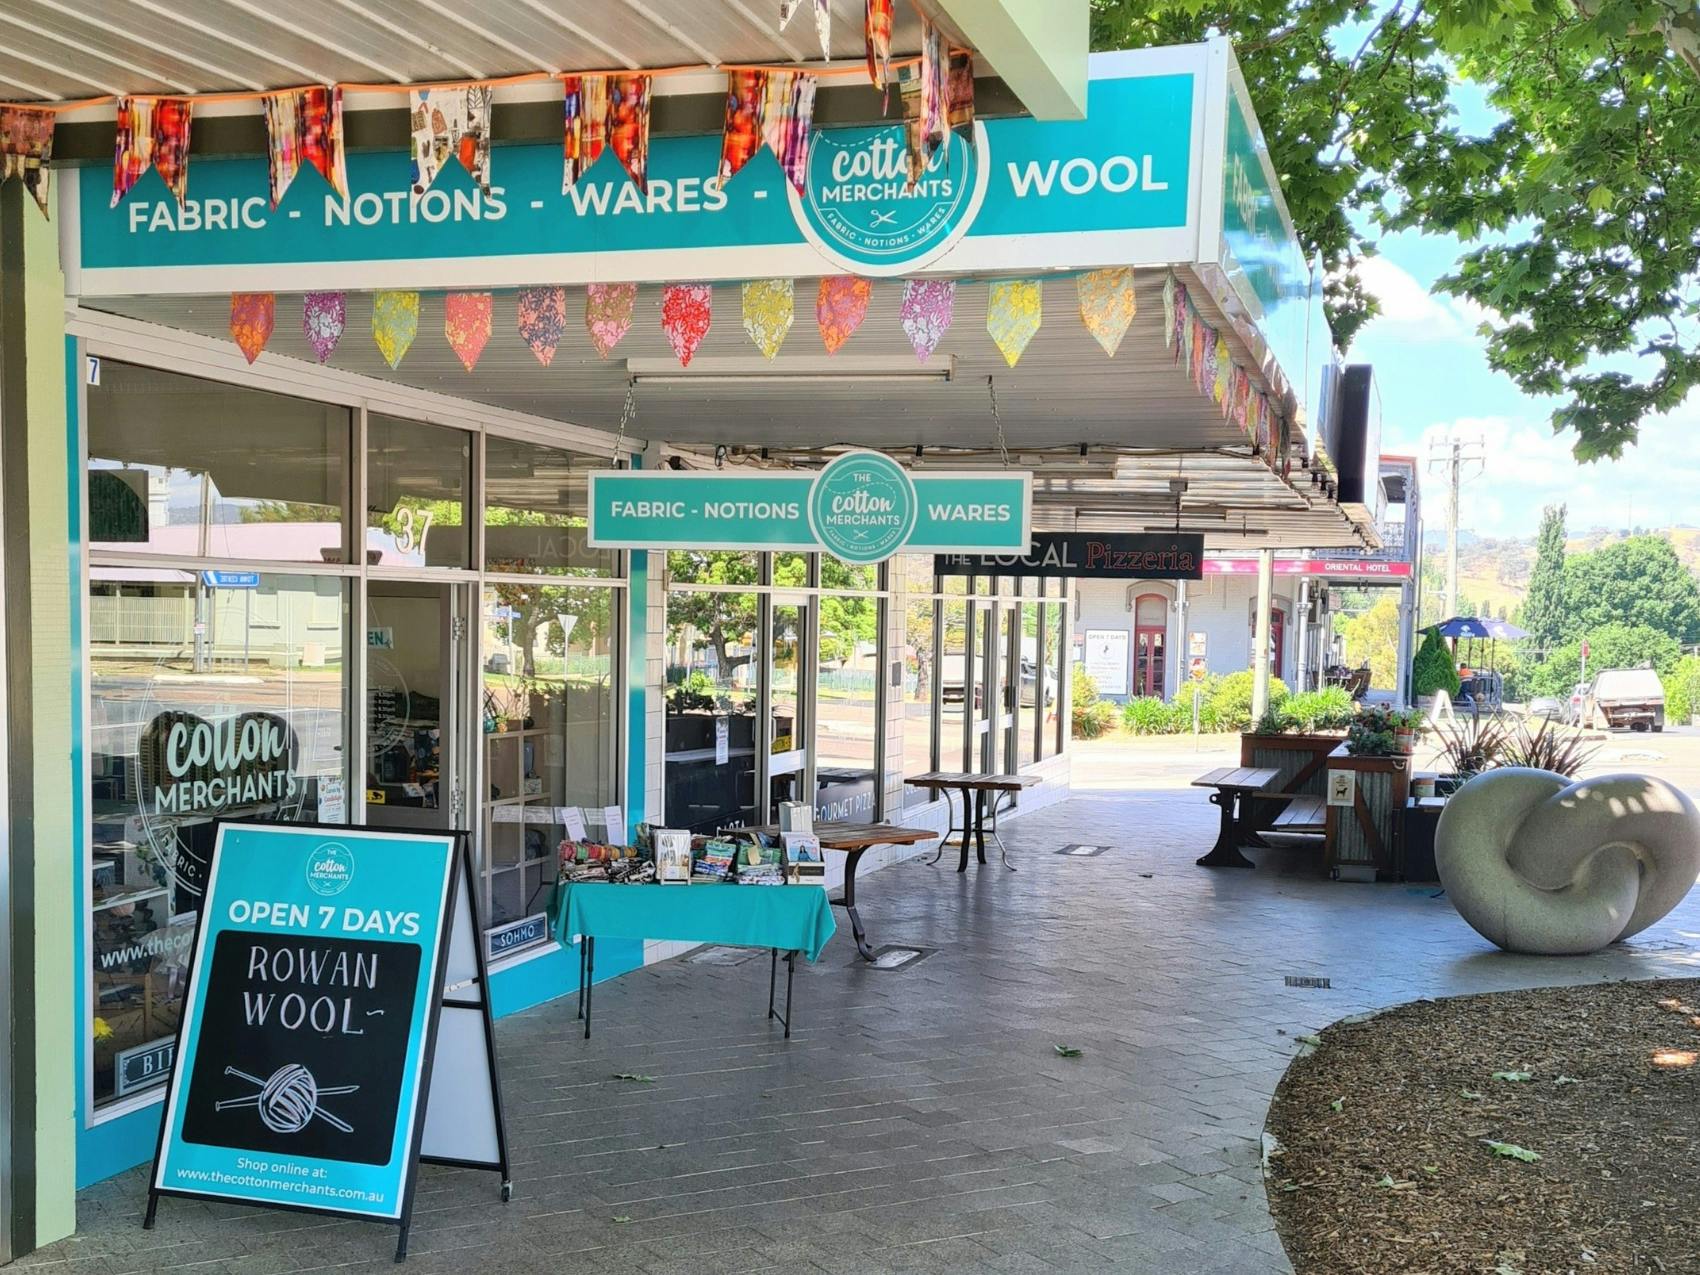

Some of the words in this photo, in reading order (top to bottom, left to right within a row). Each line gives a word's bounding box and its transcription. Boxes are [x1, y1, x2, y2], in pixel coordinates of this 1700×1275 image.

[128, 196, 267, 233] FABRIC
[324, 186, 508, 227] NOTIONS
[569, 176, 728, 217] WARES
[1007, 154, 1169, 198] WOOL
[822, 179, 953, 204] MERCHANTS
[826, 211, 857, 241] FABRIC
[864, 235, 910, 248] NOTIONS
[916, 207, 947, 236] WARES
[90, 358, 98, 383] 7
[853, 473, 872, 482] THE
[611, 501, 686, 518] FABRIC
[704, 502, 800, 519] NOTIONS
[832, 490, 893, 514] cotton
[928, 503, 1011, 521] WARES
[397, 507, 434, 554] 37
[826, 514, 900, 526] MERCHANTS
[1085, 541, 1195, 571] Pizzeria
[1324, 563, 1362, 572] ORIENTAL
[1366, 563, 1392, 572] HOTEL
[155, 769, 297, 815] MERCHANTS
[310, 871, 350, 881] MERCHANTS
[314, 858, 346, 873] cotton
[228, 899, 311, 929] OPEN
[318, 905, 336, 930] 7
[342, 907, 421, 938] DAYS
[500, 924, 535, 947] SOHMO
[100, 932, 194, 969] www.theco
[247, 945, 378, 990] ROWAN
[142, 1047, 174, 1076] BI
[236, 1156, 269, 1173] Shop
[271, 1163, 310, 1177] online
[312, 1166, 328, 1179] at:
[176, 1167, 385, 1204] www.thecottonmerchants.com.au
